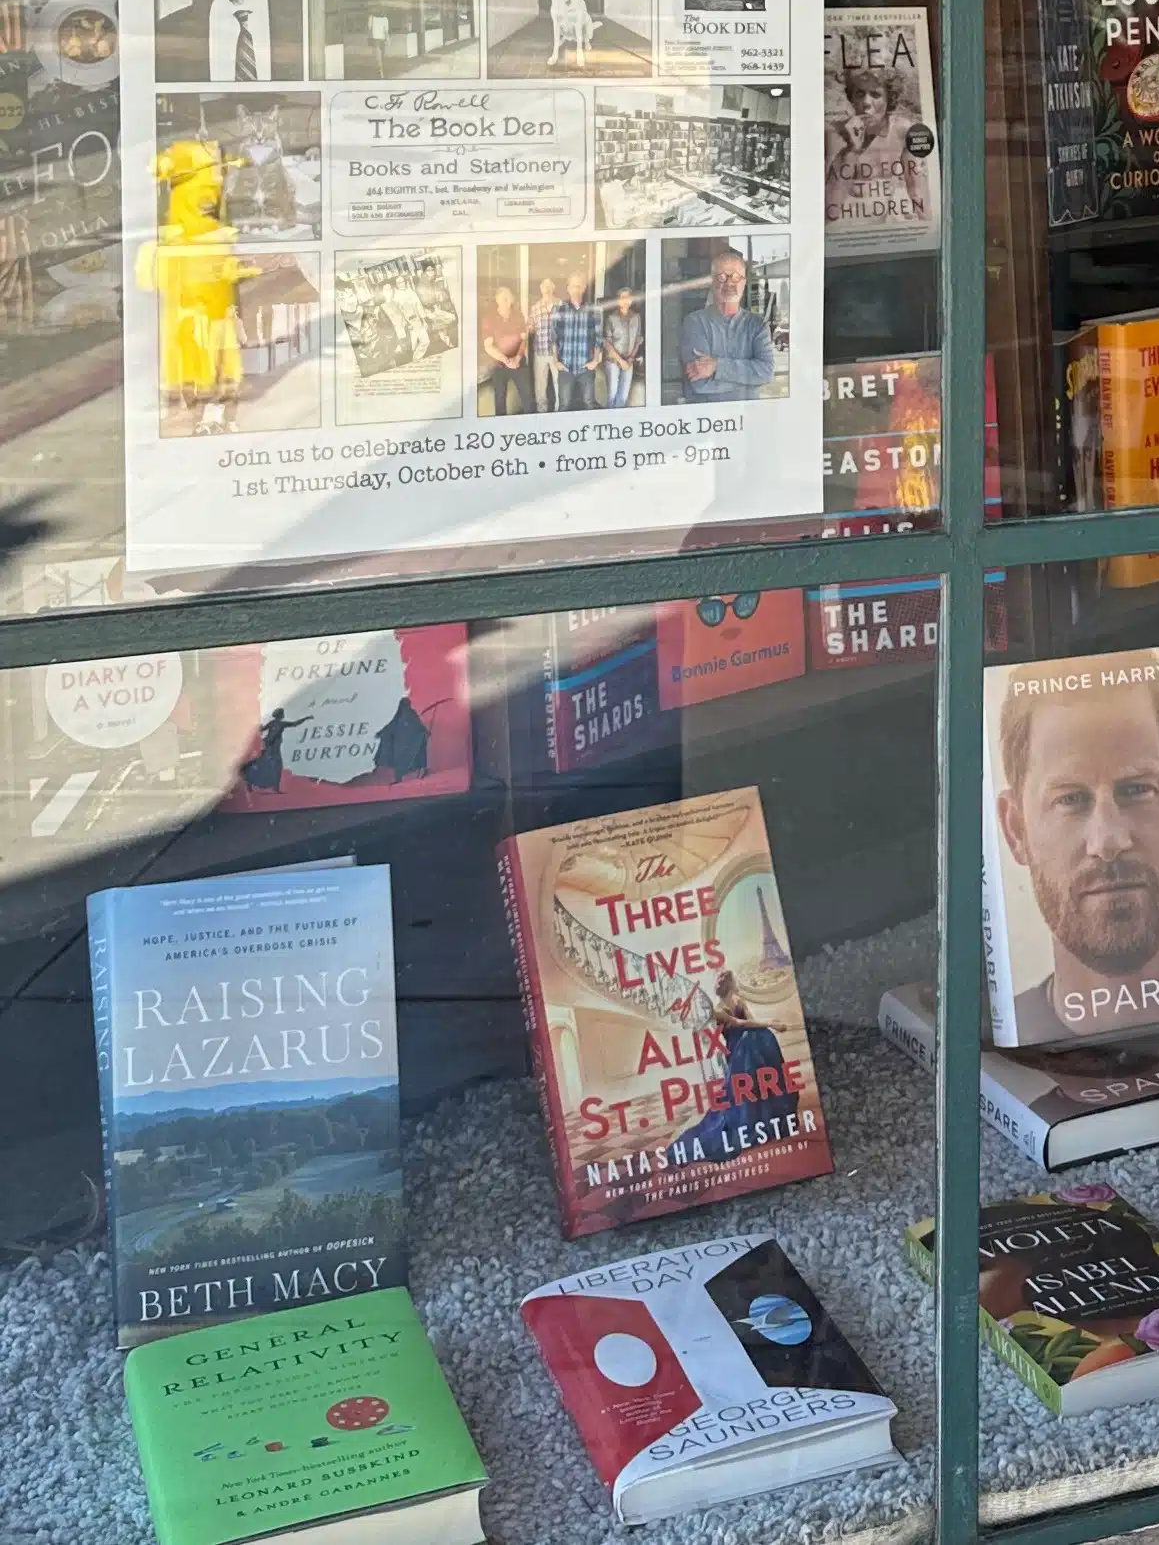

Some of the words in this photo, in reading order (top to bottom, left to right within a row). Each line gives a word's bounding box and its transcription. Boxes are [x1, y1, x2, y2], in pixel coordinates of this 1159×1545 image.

[682, 22, 730, 34] BOOK
[734, 22, 767, 34] DEN
[684, 14, 700, 23] The
[368, 117, 421, 139] The
[430, 117, 496, 138] Book
[503, 116, 554, 136] Den
[1122, 131, 1134, 148] A
[349, 160, 411, 177] Books
[420, 158, 458, 176] and
[470, 157, 572, 175] Stationery
[828, 163, 873, 181] ACID
[880, 161, 918, 177] FOR
[854, 181, 891, 197] THE
[827, 199, 924, 221] CHILDREN
[217, 447, 273, 470] Join
[277, 448, 306, 464] us
[310, 443, 335, 461] to
[340, 435, 447, 460] celebrate
[453, 431, 495, 452] 120
[500, 426, 562, 452] years
[567, 424, 590, 444] of
[592, 422, 634, 442] The
[640, 418, 692, 438] Book
[697, 414, 745, 435] Den!
[1145, 434, 1151, 449] A
[231, 476, 269, 498] 1st
[273, 468, 392, 495] Thursday,
[398, 461, 486, 485] October
[490, 457, 529, 479] 6th
[555, 452, 607, 474] from
[613, 450, 626, 470] 5
[633, 447, 668, 471] pm
[683, 443, 731, 467] 9pm
[825, 600, 888, 628] THE
[316, 638, 348, 655] OF
[61, 667, 131, 691] DIARY
[136, 659, 168, 679] OF
[275, 658, 389, 682] FORTUNE
[1013, 672, 1093, 697] PRINCE
[73, 695, 90, 713] A
[98, 685, 156, 709] VOID
[299, 721, 369, 743] JESSIE
[291, 741, 376, 763] BURTON
[635, 854, 677, 883] The
[143, 934, 179, 946] HOPE,
[184, 929, 235, 942] JUSTICE,
[240, 926, 263, 937] AND
[268, 923, 289, 934] THE
[295, 919, 339, 931] FUTURE
[344, 917, 358, 926] OF
[165, 947, 228, 961] AMERICA'S
[234, 941, 293, 955] OVERDOSE
[299, 936, 338, 948] CRISIS
[982, 907, 998, 996] SPARE
[133, 966, 373, 1030] RAISING
[124, 1019, 383, 1088] LAZARUS
[586, 1141, 705, 1187] NATASHA
[722, 1109, 817, 1154] LESTER
[605, 1187, 627, 1199] NEW
[630, 1180, 654, 1194] YORK
[657, 1172, 686, 1187] TIMES
[690, 1153, 754, 1178] BESTSELLING
[757, 1145, 796, 1163] AUTHOR
[798, 1141, 809, 1152] OF
[645, 1190, 665, 1203] THE
[669, 1182, 700, 1198] PARIS
[704, 1164, 770, 1189] SEAMSTRESS
[558, 1238, 755, 1295] LIBERATION
[632, 1267, 695, 1295] DAY
[1025, 1257, 1149, 1294] ISABEL
[140, 1276, 255, 1322] BETH
[272, 1257, 388, 1302] MACY
[185, 1318, 366, 1366] GENERAL
[163, 1331, 403, 1397] RELATIVITY
[667, 1387, 822, 1436] GEORGE
[649, 1393, 857, 1461] SAUNDERS
[216, 1477, 312, 1506] LEONARD
[321, 1449, 420, 1482] SUSSKIND
